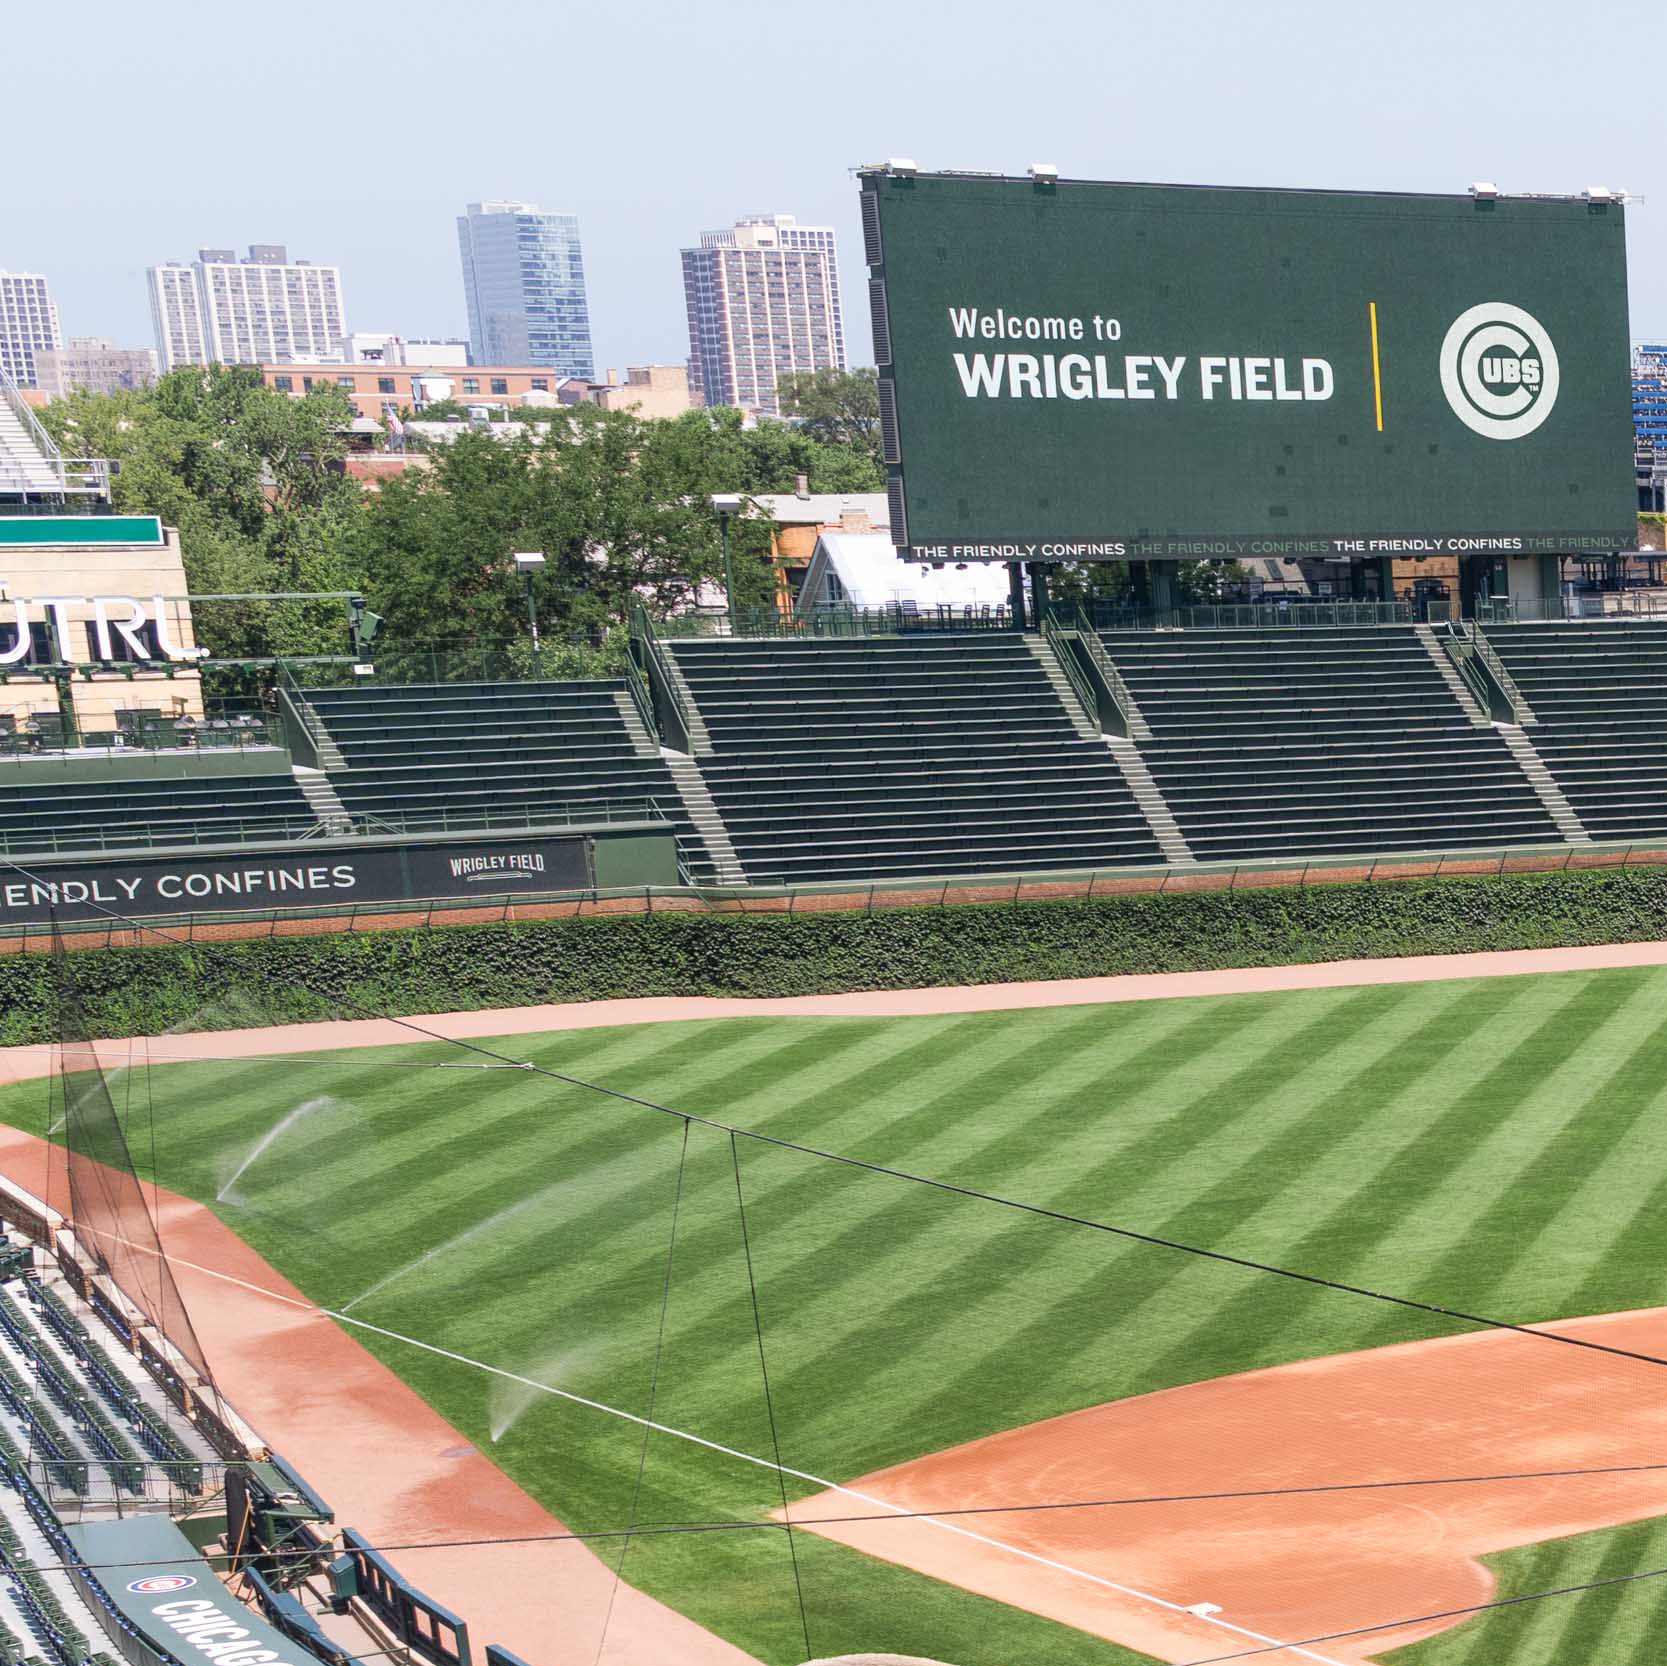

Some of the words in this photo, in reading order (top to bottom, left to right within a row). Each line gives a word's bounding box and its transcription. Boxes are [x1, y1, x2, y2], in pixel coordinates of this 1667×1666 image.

[949, 307, 1083, 340] Welcome
[1093, 314, 1121, 341] to
[953, 353, 1187, 400] WRIGLEY
[1200, 356, 1335, 401] FIELD
[913, 546, 947, 558] THE
[952, 545, 1037, 558] FRIENDLY
[1041, 542, 1125, 557] CONFINES
[1131, 543, 1162, 554] THE
[1167, 542, 1245, 554] FRIENDLY
[1250, 540, 1329, 553] CONFINES
[1333, 540, 1365, 551] THE
[1369, 540, 1444, 552] FRIENDLY
[1447, 538, 1521, 551] CONFINES
[1525, 538, 1555, 549] THE
[1559, 537, 1631, 549] FRIENDLY
[450, 855, 505, 877] WRIGLEY
[509, 853, 546, 872] FIELD
[0, 876, 144, 908] ENDLY
[156, 864, 357, 899] CONFINES
